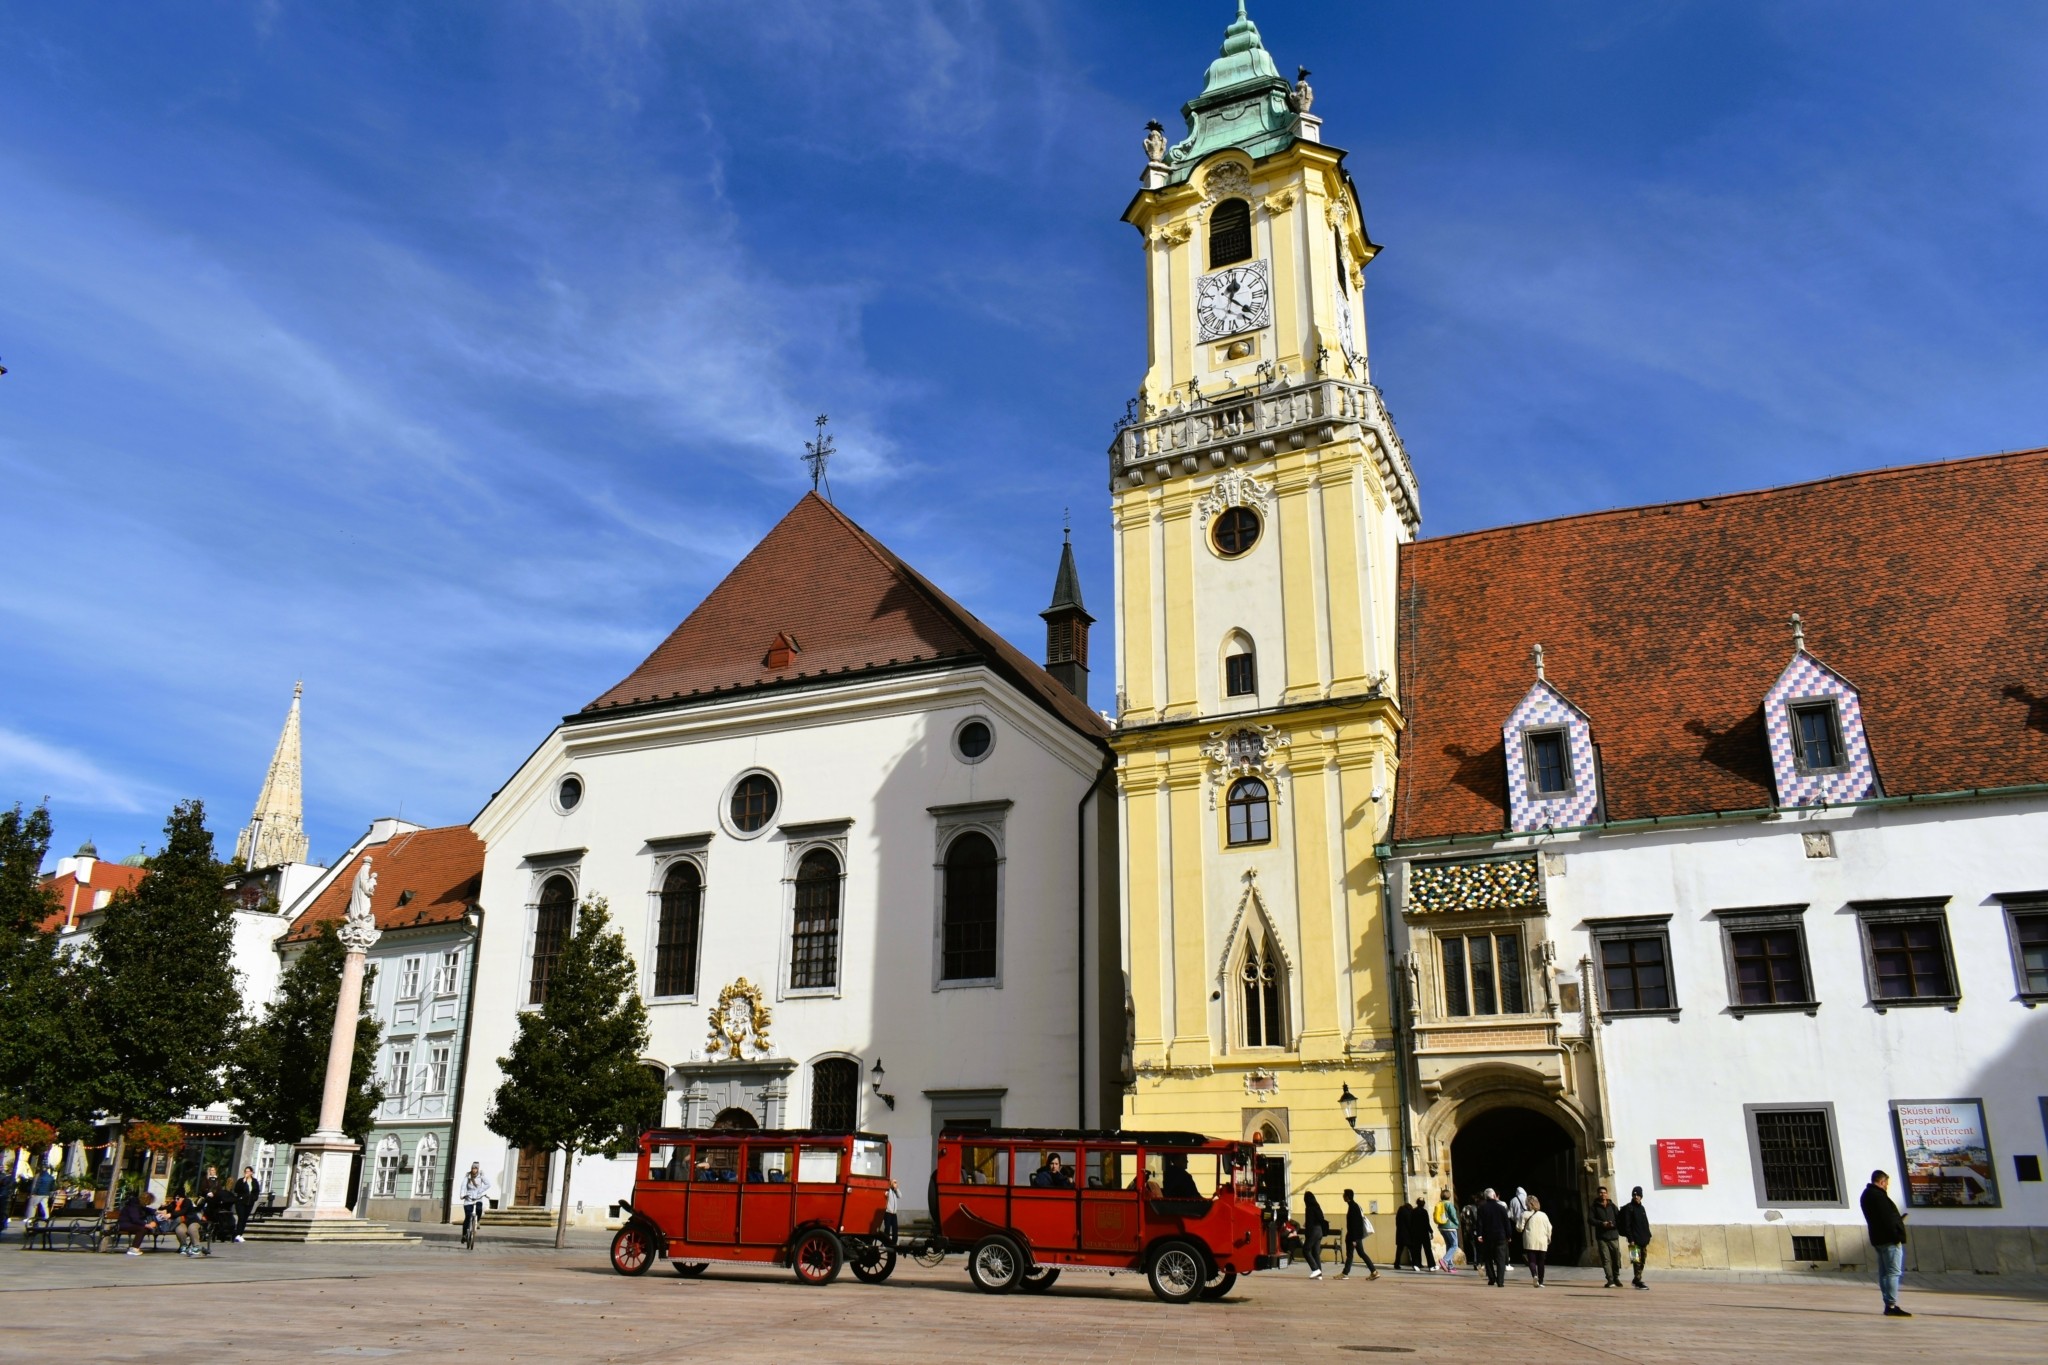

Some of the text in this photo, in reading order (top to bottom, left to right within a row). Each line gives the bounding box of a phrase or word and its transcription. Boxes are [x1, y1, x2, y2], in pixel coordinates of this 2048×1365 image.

[1212, 279, 1224, 291] XI
[1247, 279, 1259, 289] II
[1203, 292, 1215, 301] X
[1252, 289, 1263, 299] III
[1229, 319, 1238, 330] VI
[1903, 1127, 1921, 1136] Try
[1931, 1127, 1974, 1136] different
[1905, 1137, 1961, 1147] perspective
